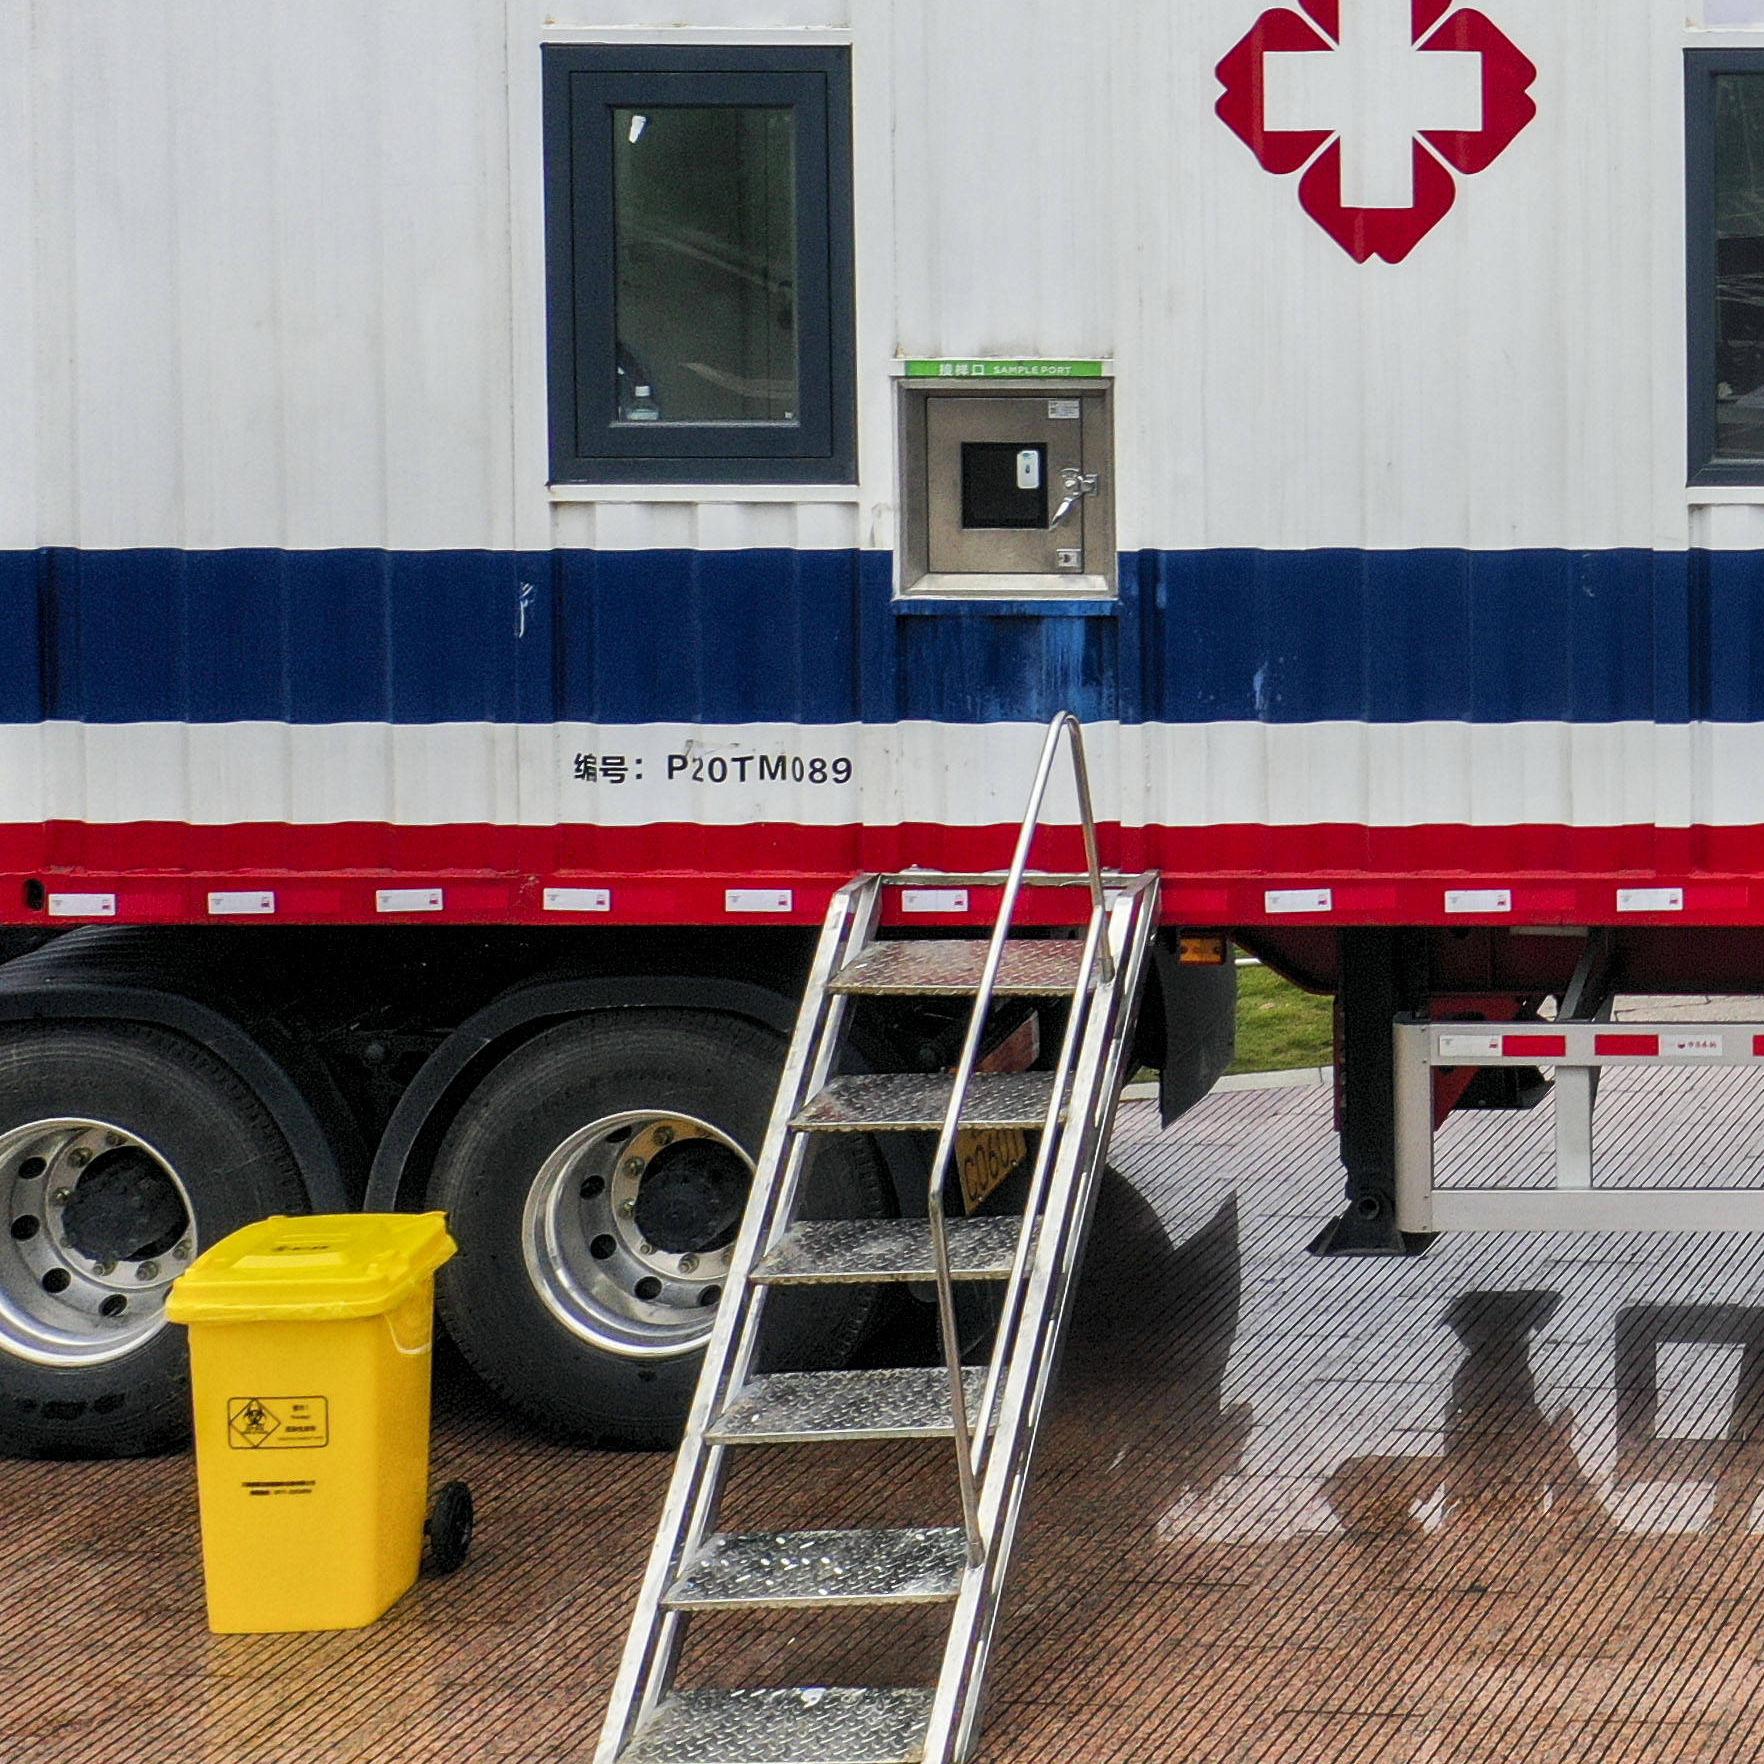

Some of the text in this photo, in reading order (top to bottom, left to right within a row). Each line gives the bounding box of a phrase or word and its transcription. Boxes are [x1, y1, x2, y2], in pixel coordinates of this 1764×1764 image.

[992, 365, 1073, 375] SAMPLE PORT
[667, 754, 853, 784] P20TM089
